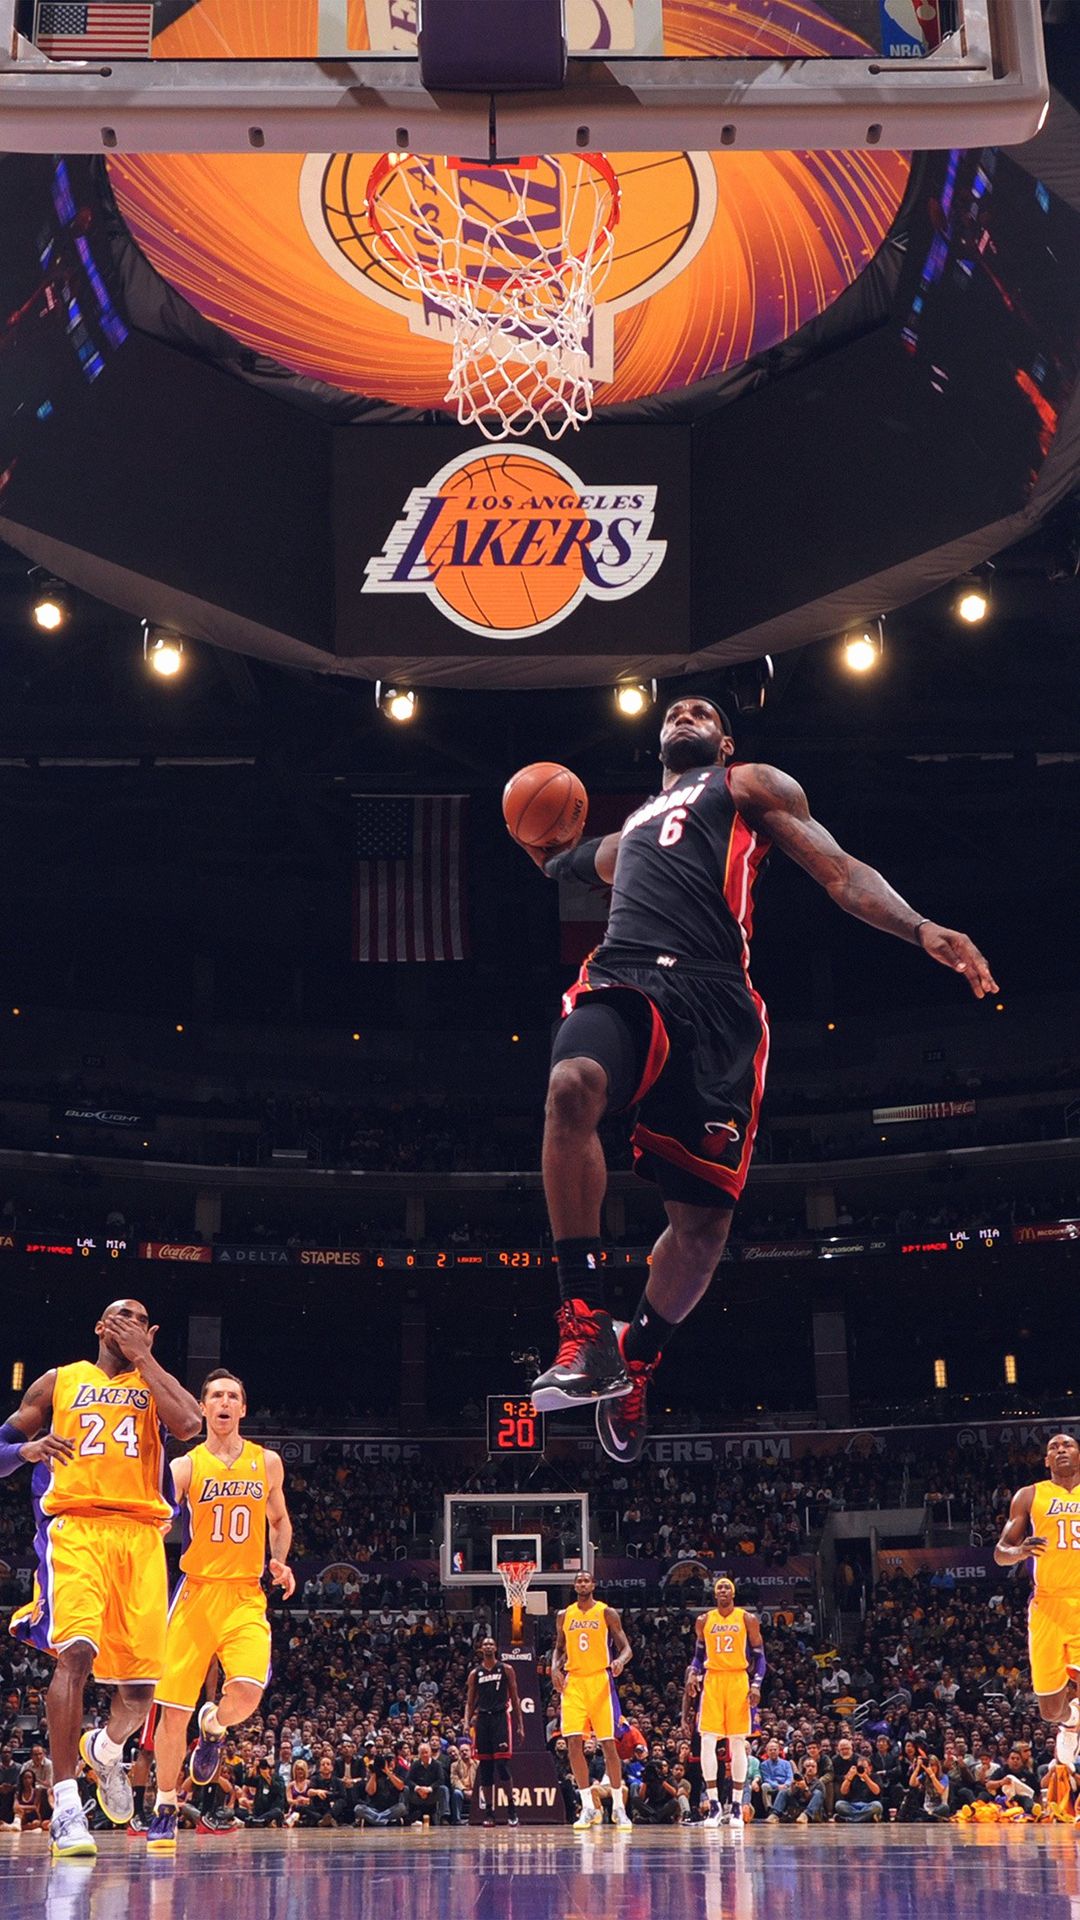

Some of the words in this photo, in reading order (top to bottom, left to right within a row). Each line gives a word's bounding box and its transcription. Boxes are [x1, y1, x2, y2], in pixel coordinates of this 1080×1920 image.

[466, 495, 513, 510] LOS
[520, 494, 645, 510] ANGELES
[378, 496, 654, 589] LAKERS
[657, 807, 688, 847] 6
[64, 1109, 95, 1119] BUD
[101, 1113, 142, 1122] LIGHT
[950, 1231, 970, 1241] LAL
[979, 1228, 1000, 1239] MIA
[77, 1238, 96, 1248] LAL
[106, 1240, 127, 1249] MIA
[821, 1244, 864, 1254] Panasonic
[955, 1241, 964, 1250] 0
[985, 1238, 993, 1247] 0
[82, 1247, 89, 1256] 0
[111, 1249, 119, 1258] 0
[236, 1252, 289, 1262] DELTA
[300, 1252, 361, 1265] STAPLES
[437, 1253, 446, 1267] 2
[743, 1248, 812, 1260] Budweiser
[71, 1384, 150, 1411] LAKERS
[503, 1402, 538, 1418] 9:23
[80, 1413, 139, 1458] 24
[498, 1418, 535, 1447] 20
[198, 1478, 263, 1503] LAKERS
[211, 1504, 251, 1544] 10
[1056, 1519, 1080, 1550] 15
[568, 1619, 599, 1631] LAKERS
[579, 1632, 590, 1652] 6
[716, 1635, 734, 1653] 12
[497, 1787, 533, 1807] NBA
[533, 1787, 557, 1806] TV
